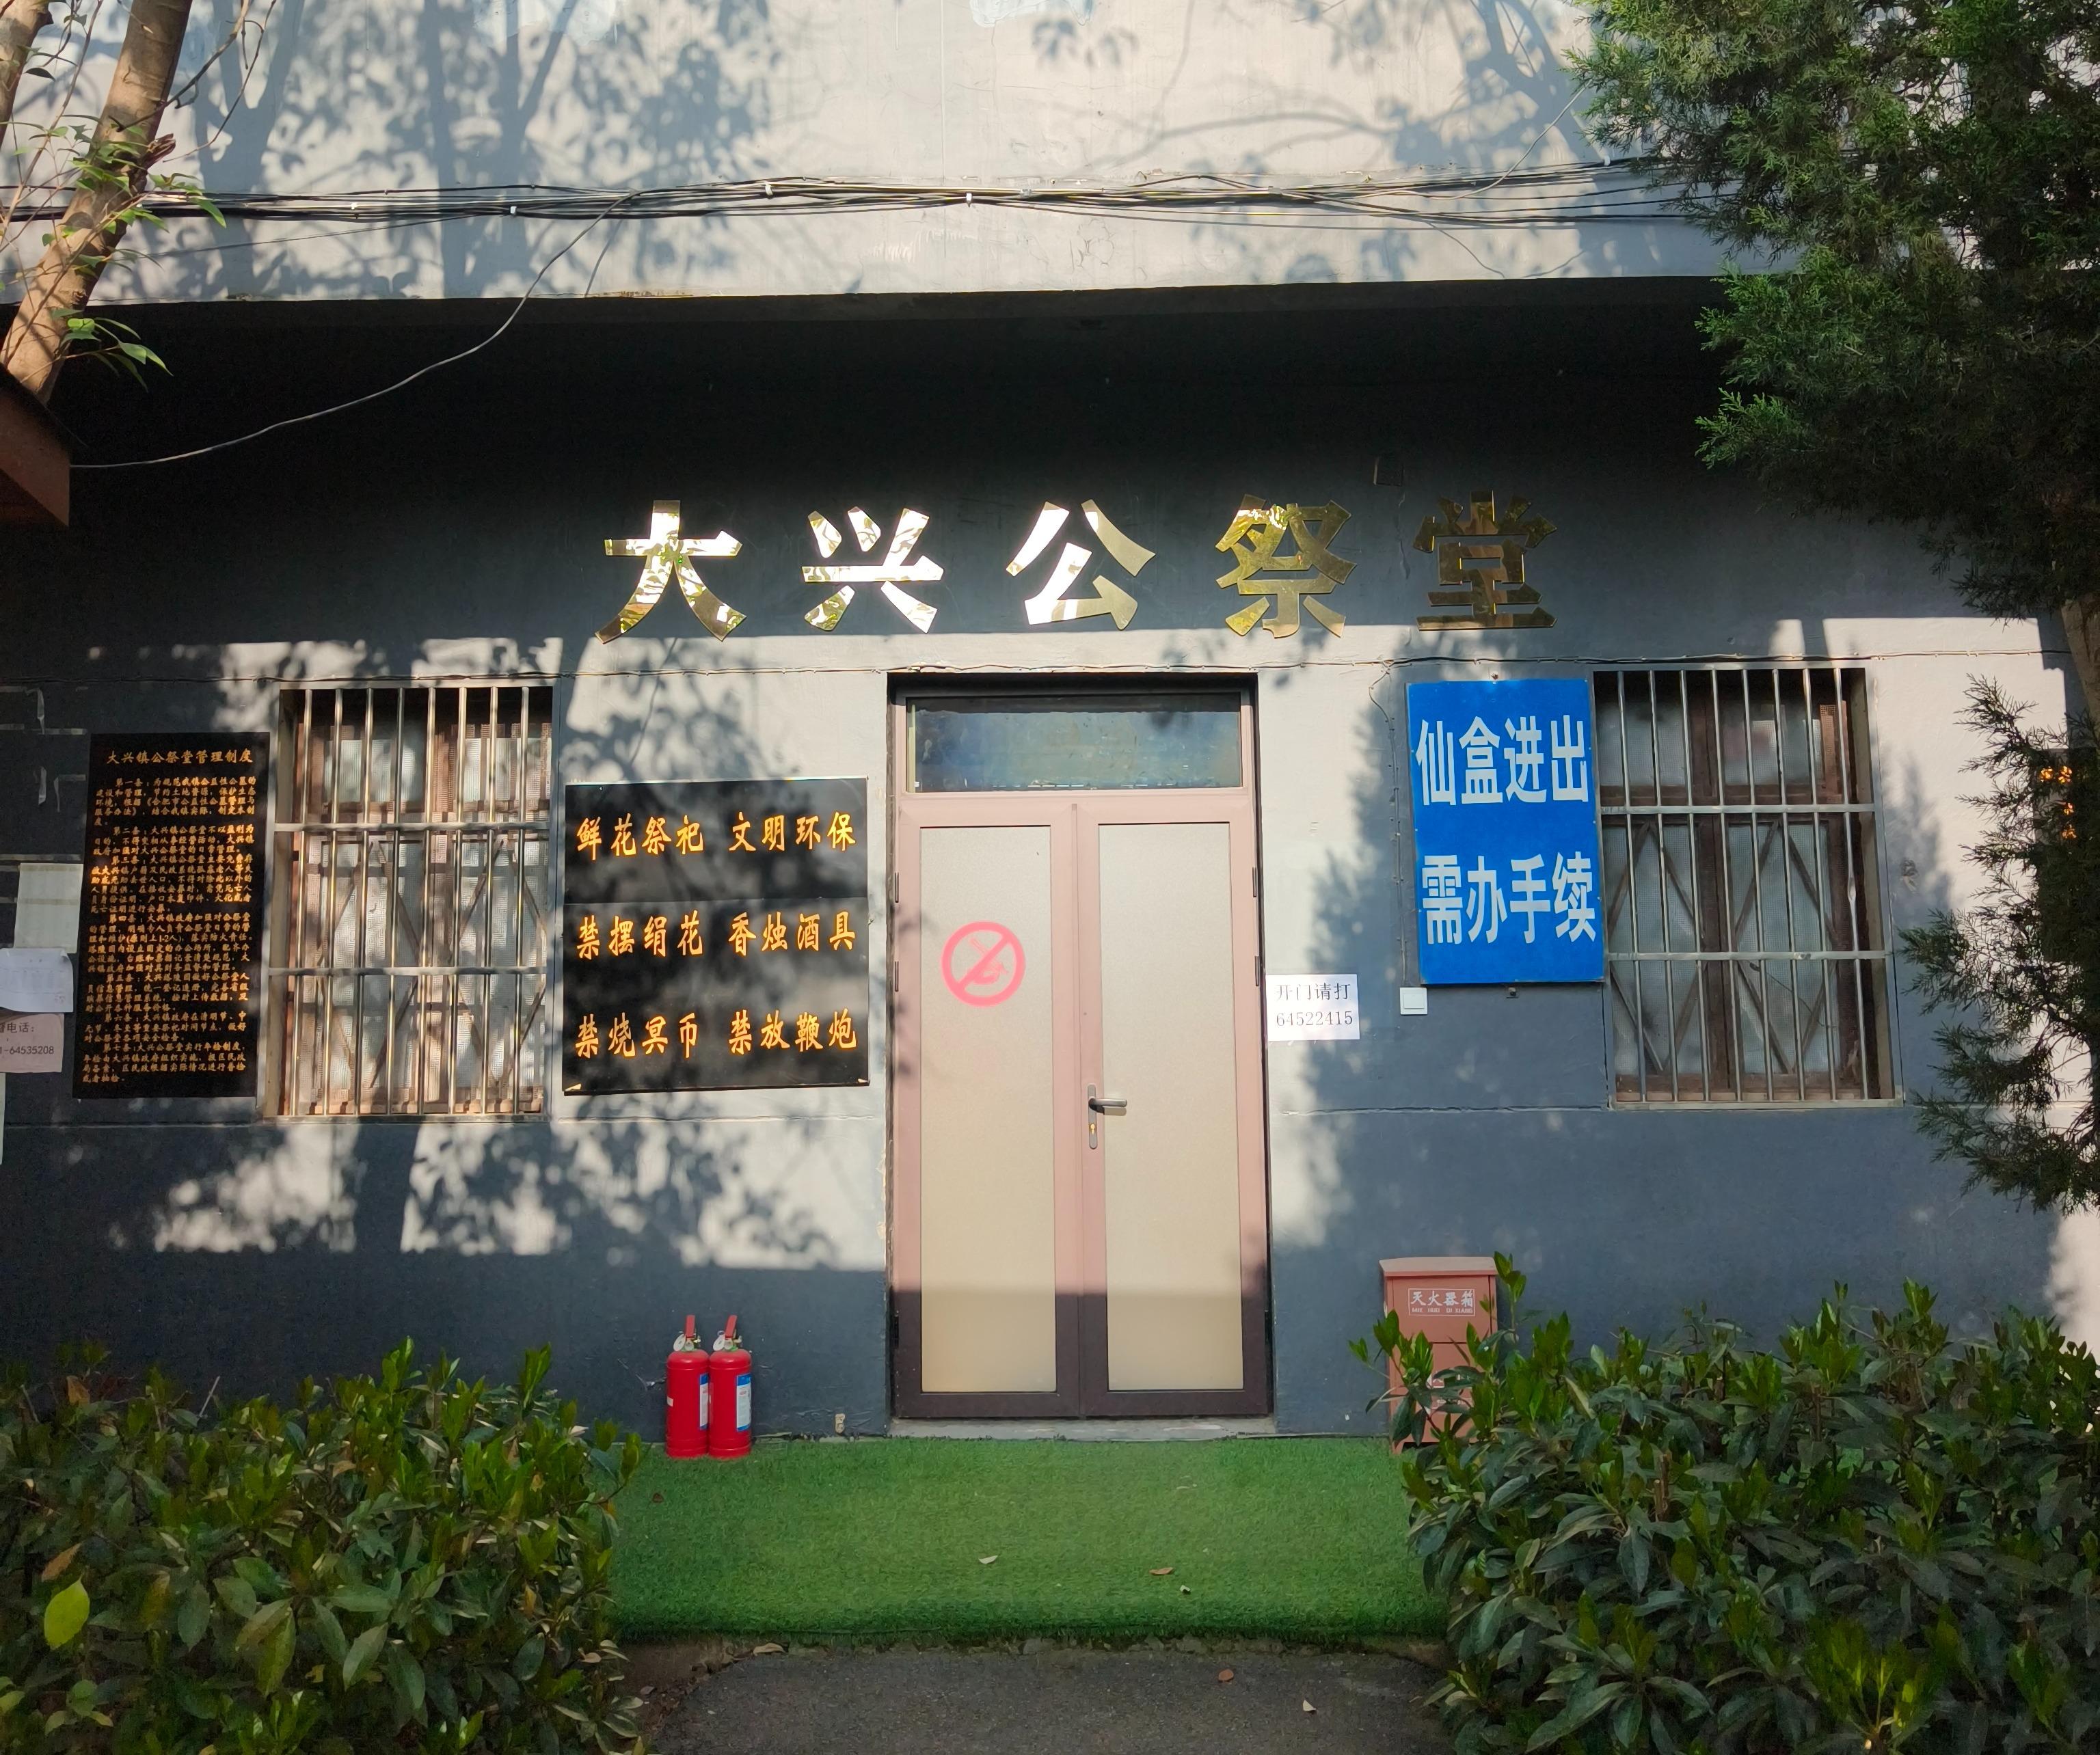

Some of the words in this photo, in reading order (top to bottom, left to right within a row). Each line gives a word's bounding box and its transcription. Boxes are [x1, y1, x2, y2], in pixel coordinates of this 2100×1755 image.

[593, 489, 1559, 644] 大兴公祭堂
[107, 749, 253, 764] 大兴镇公祭堂管理制度
[1415, 714, 1589, 806] 仙盒进出
[576, 813, 704, 860] 鲜花祭祀
[729, 811, 856, 852] 文明环保
[1421, 851, 1596, 944] 需办手续
[576, 910, 703, 960] 禁摆绢花
[728, 911, 856, 956] 香烛酒具
[1276, 982, 1351, 1001] 开门请打
[575, 1011, 699, 1059] 禁烧冥币
[729, 1008, 857, 1055] 禁放鞭炮
[1276, 1011, 1353, 1028] 64522415
[1410, 1290, 1473, 1307] 灭火器箱
